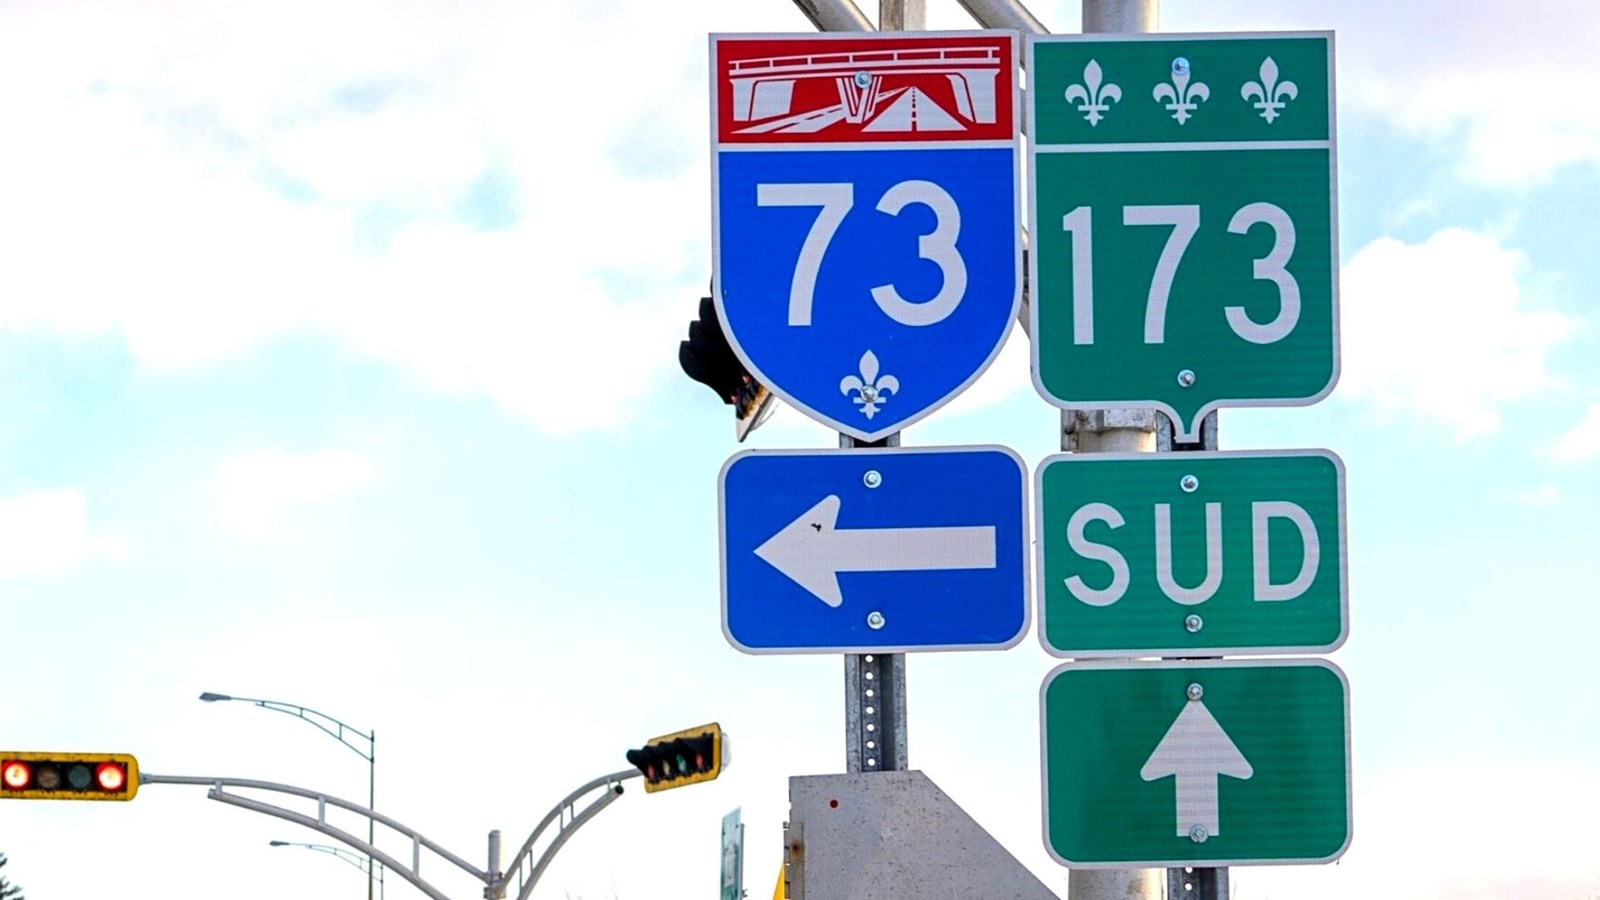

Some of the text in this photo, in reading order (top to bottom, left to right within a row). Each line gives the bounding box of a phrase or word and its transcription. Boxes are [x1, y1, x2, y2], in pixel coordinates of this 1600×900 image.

[757, 180, 967, 327] 73
[1062, 202, 1302, 345] 173
[1064, 501, 1321, 607] SUD
